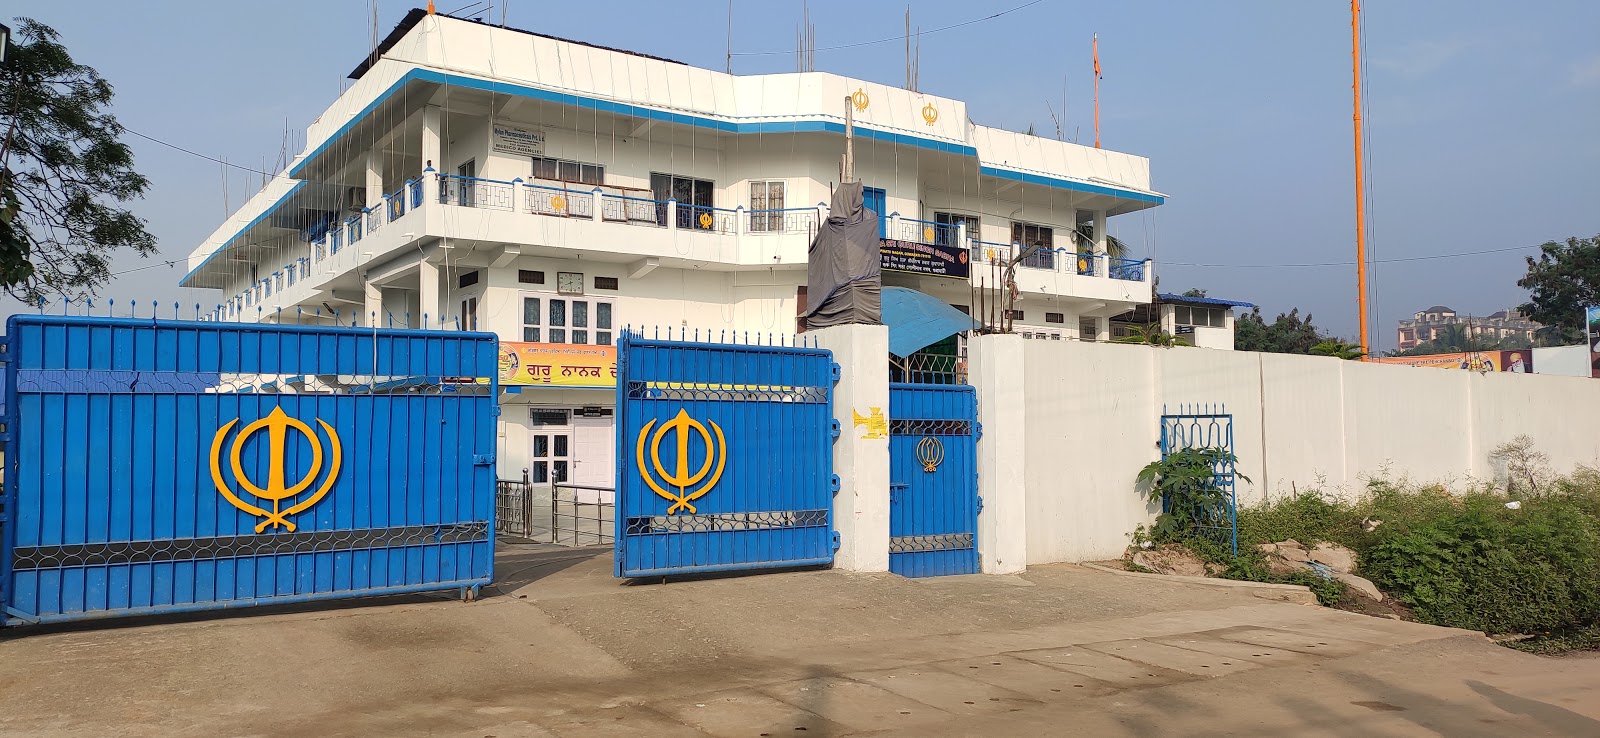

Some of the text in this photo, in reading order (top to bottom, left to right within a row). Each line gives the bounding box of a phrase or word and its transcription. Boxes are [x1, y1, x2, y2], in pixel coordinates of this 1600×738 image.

[897, 241, 915, 250] GURU
[916, 244, 934, 254] SINGH
[935, 249, 955, 263] SABHA
[526, 364, 552, 383] ਗੁਰੂ
[561, 365, 601, 378] ਨਾਨਕ
